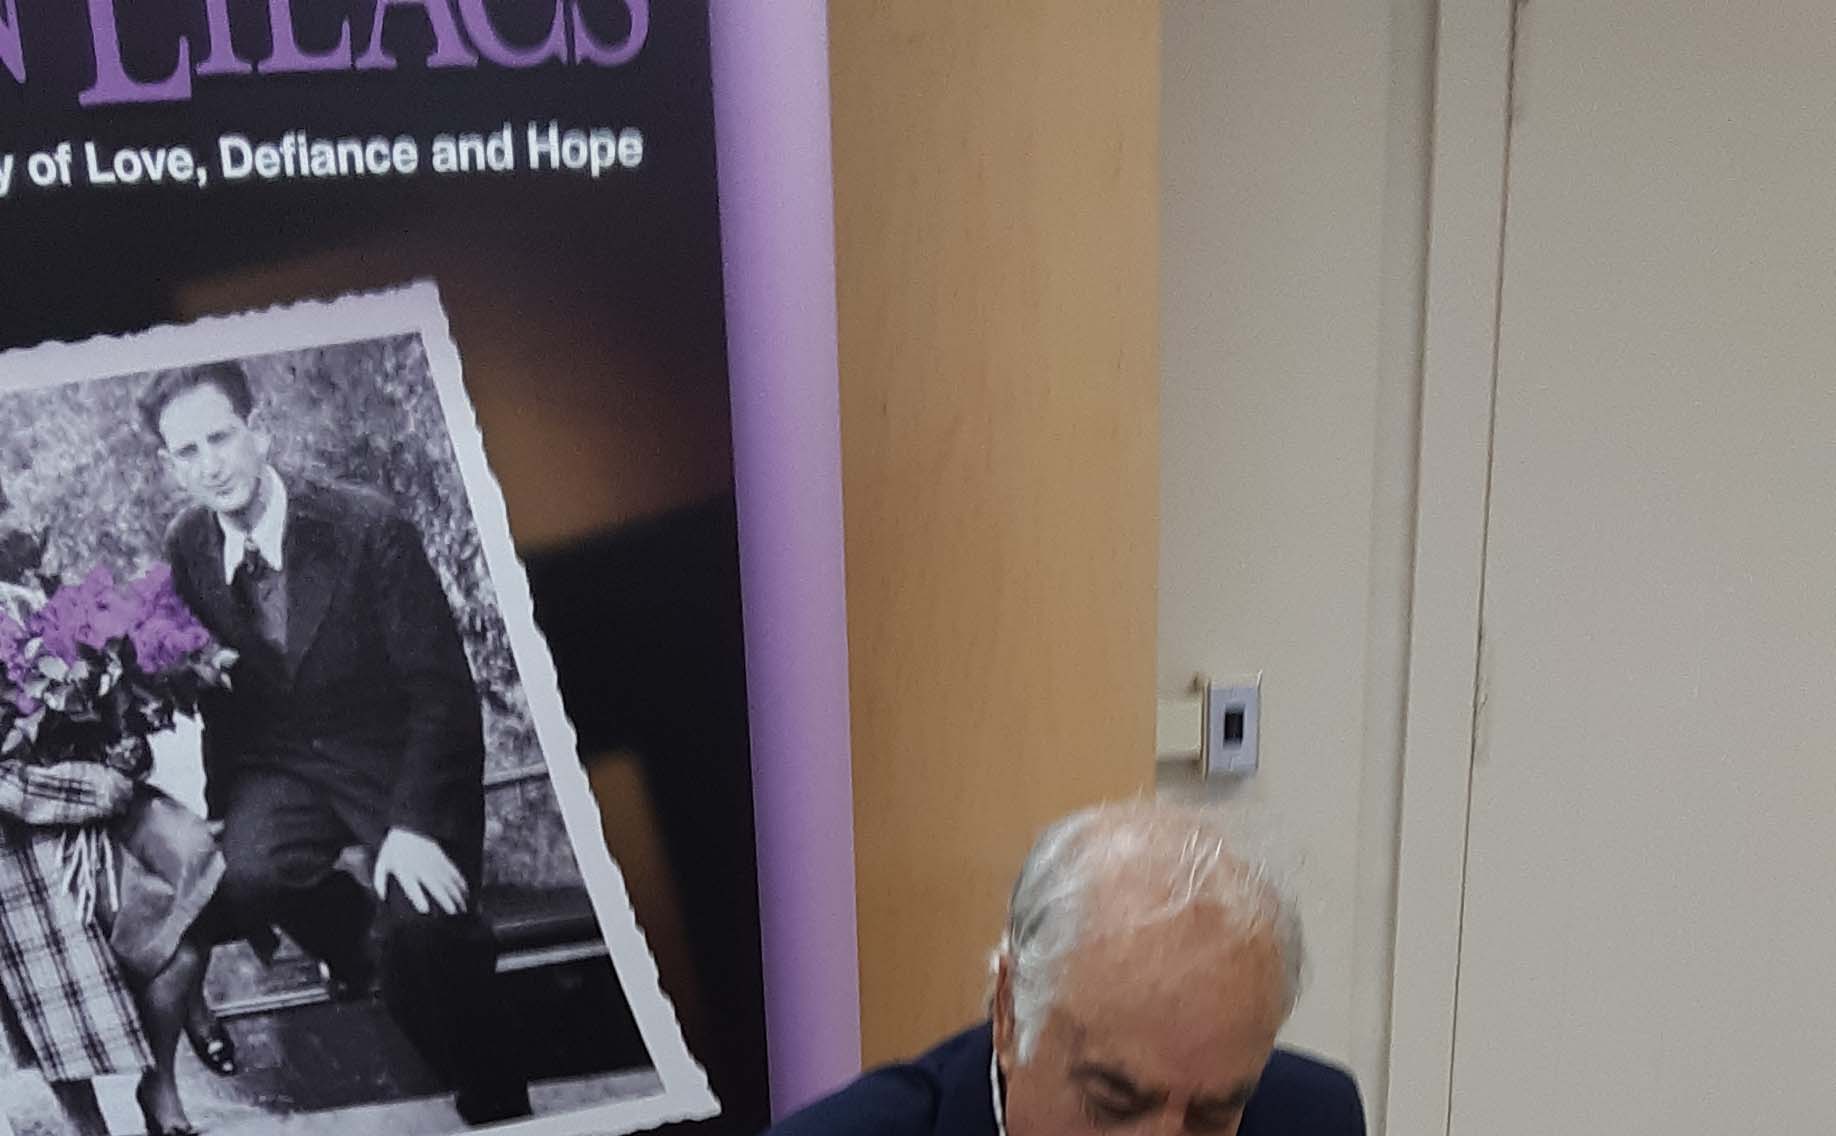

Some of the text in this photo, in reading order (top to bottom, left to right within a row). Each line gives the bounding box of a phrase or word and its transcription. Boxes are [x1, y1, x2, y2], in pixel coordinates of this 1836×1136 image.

[28, 140, 72, 187] of
[84, 140, 207, 188] Love,
[218, 128, 418, 179] Defiance
[432, 121, 514, 172] and
[527, 119, 643, 177] Hope
